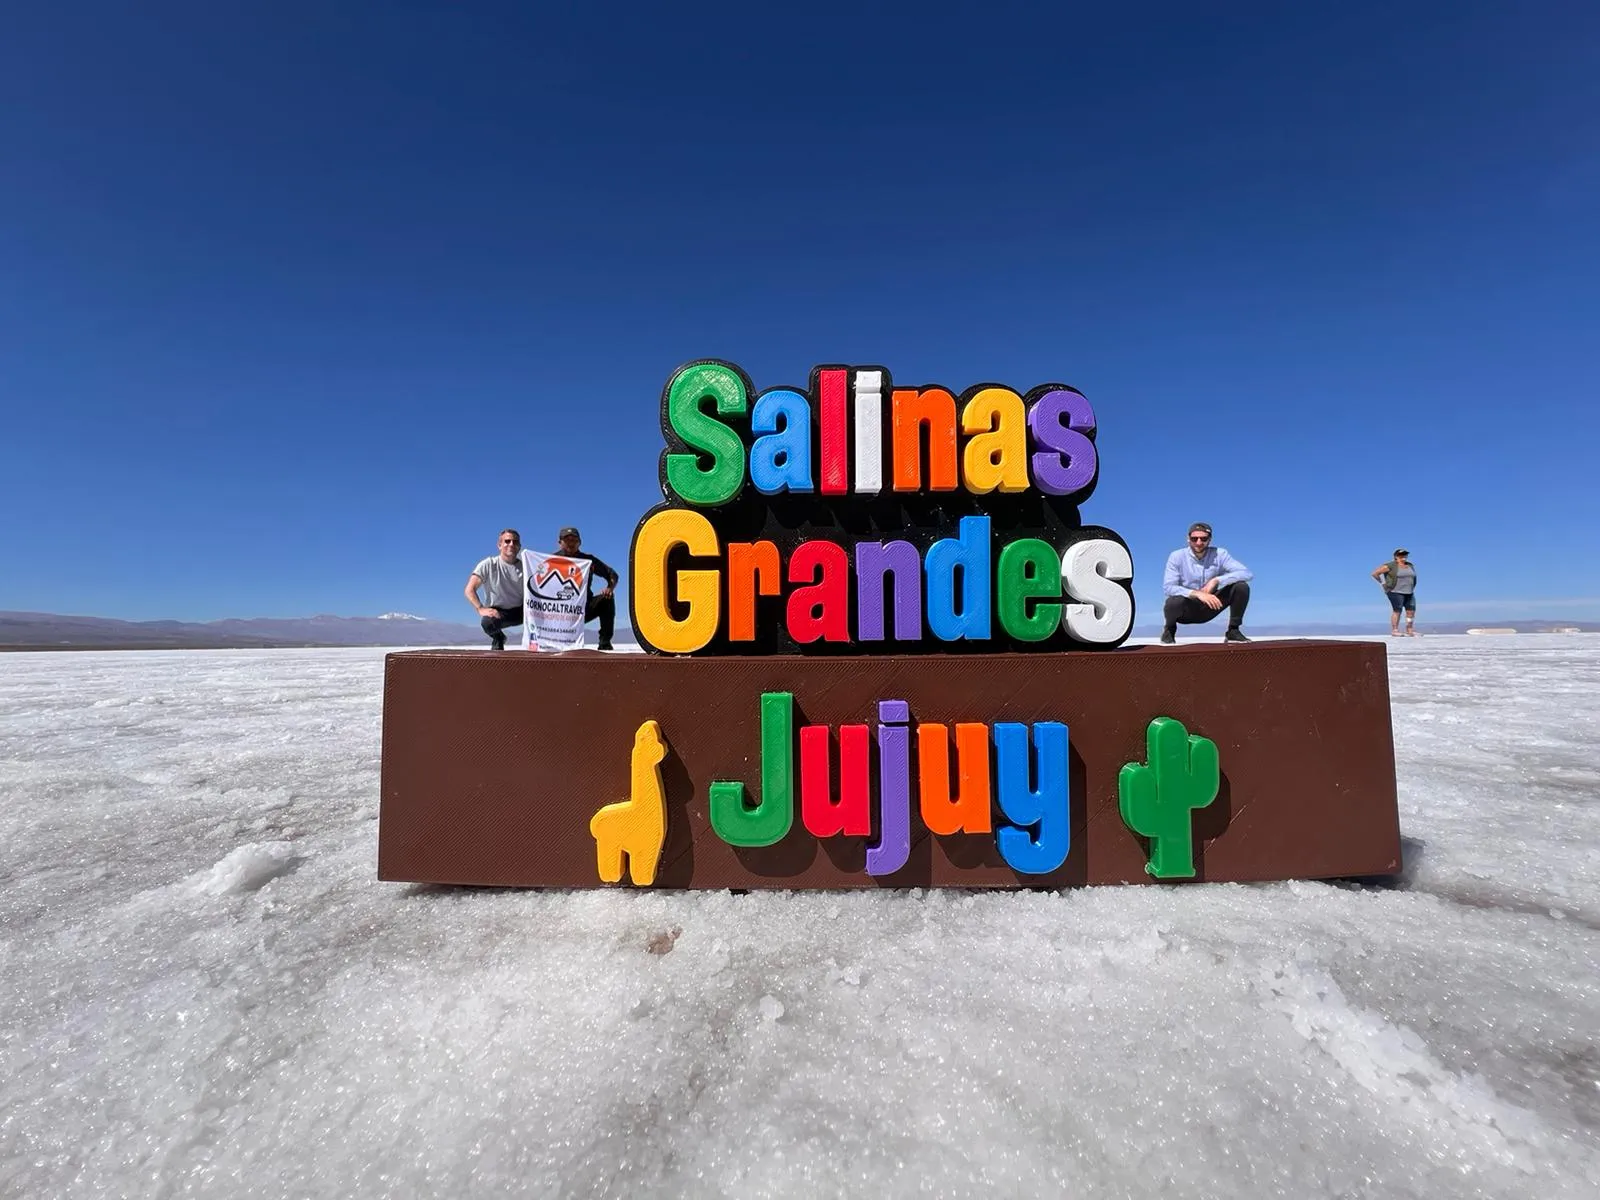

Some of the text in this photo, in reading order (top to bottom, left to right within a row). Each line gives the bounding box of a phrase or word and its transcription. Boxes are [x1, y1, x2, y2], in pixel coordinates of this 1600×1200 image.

[666, 363, 1098, 504] Salinas
[633, 509, 1134, 653] Grandes
[709, 691, 1070, 875] Jujuy
